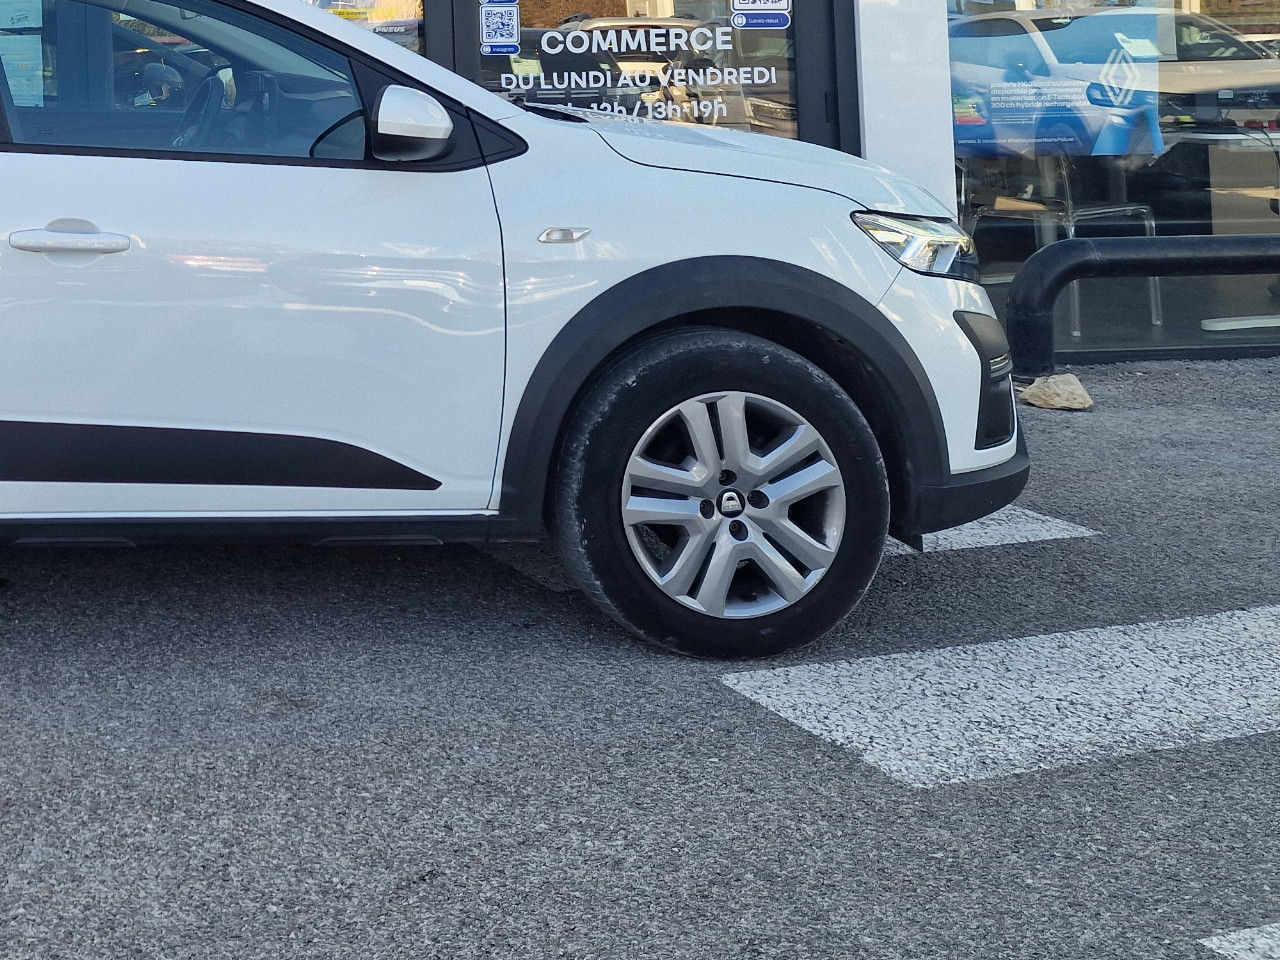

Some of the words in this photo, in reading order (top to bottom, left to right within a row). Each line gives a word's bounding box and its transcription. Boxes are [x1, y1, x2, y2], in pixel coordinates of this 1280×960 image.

[540, 27, 733, 55] COMMERCE
[501, 73, 534, 90] DU
[540, 70, 611, 90] LUNDI
[617, 69, 651, 88] AU
[654, 66, 777, 87] VENDREDI
[646, 100, 728, 119] 13h-19h
